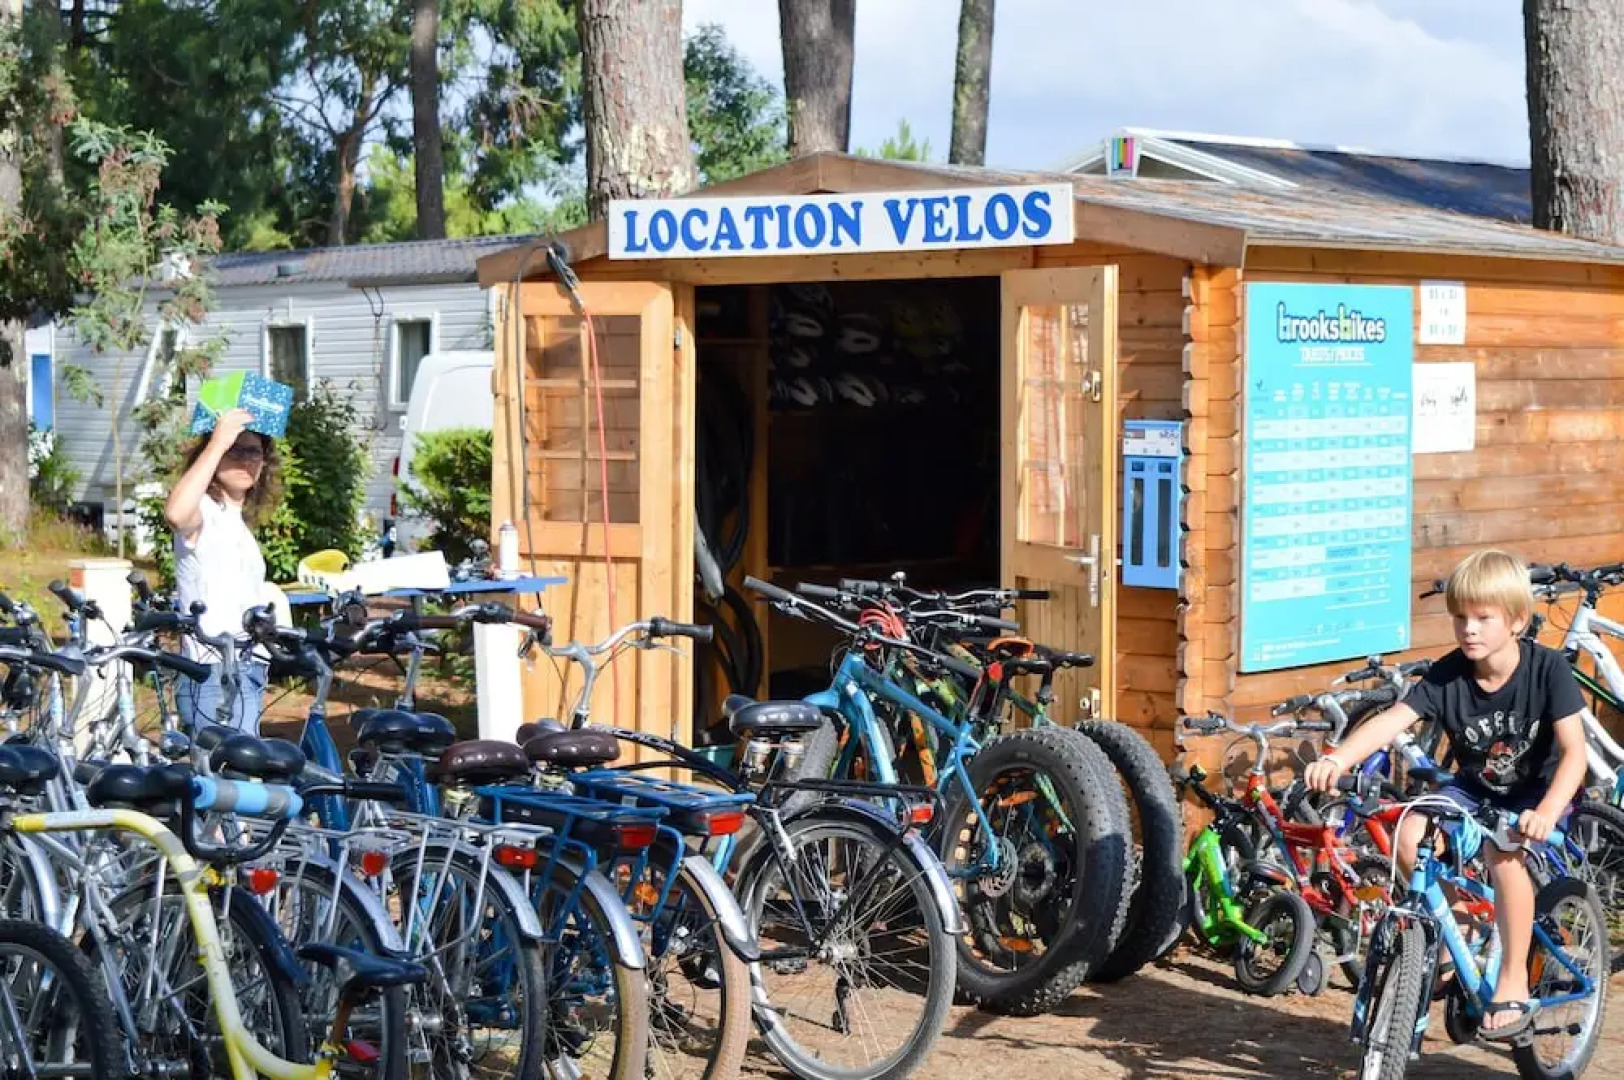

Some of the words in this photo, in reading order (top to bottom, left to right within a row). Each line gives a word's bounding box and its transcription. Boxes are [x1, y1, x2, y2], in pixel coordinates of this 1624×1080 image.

[623, 200, 863, 253] LOCATION
[883, 189, 1053, 245] VELOS
[1277, 302, 1387, 342] brooksbikes
